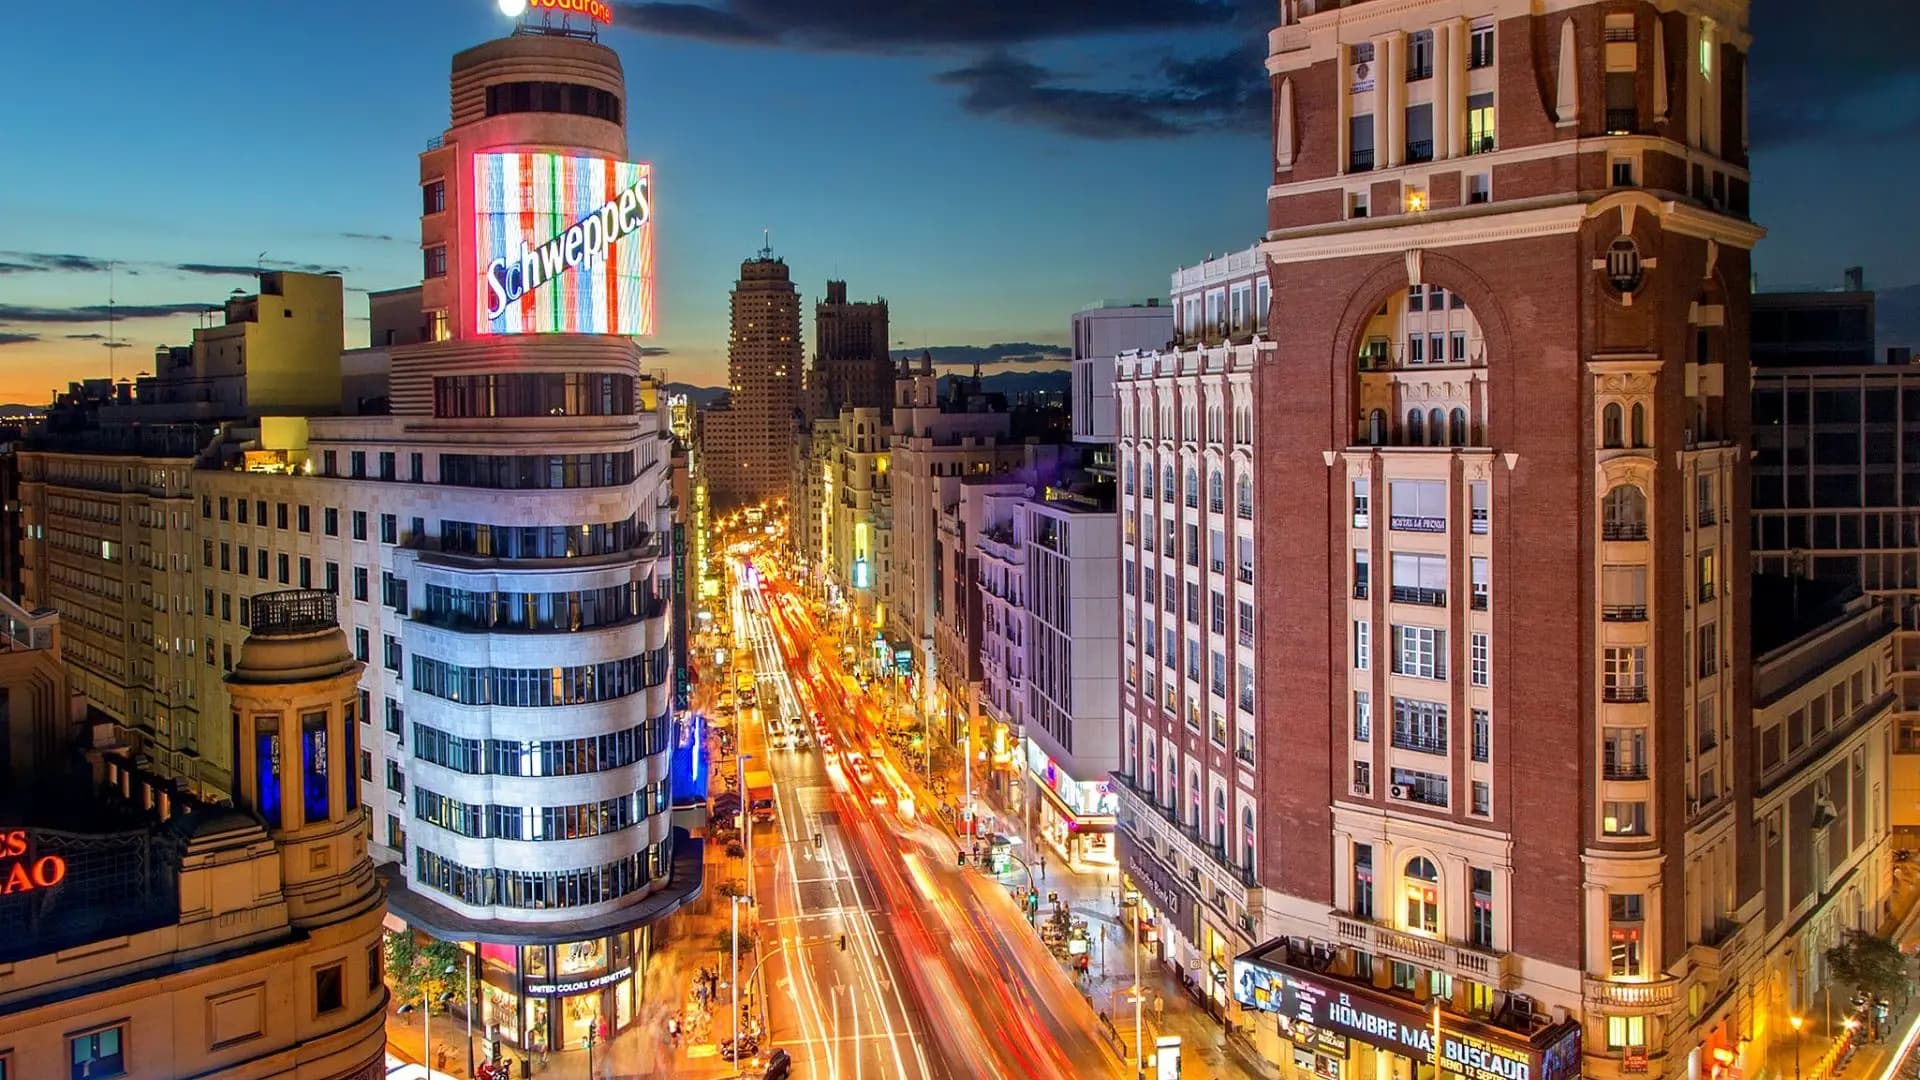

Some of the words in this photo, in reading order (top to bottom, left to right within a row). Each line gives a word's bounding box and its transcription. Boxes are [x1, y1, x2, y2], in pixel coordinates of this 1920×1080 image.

[488, 176, 649, 319] Schweppes
[675, 526, 685, 594] HOTEL
[677, 667, 686, 706] REX
[0, 855, 66, 895] AO
[528, 984, 556, 994] UNITED
[557, 981, 589, 993] COLORS
[589, 977, 600, 988] OF
[600, 966, 632, 986] BENETTON
[1339, 992, 1351, 1007] EL
[1329, 1002, 1397, 1041] HOMBRE
[1427, 1052, 1463, 1073] ESRENO
